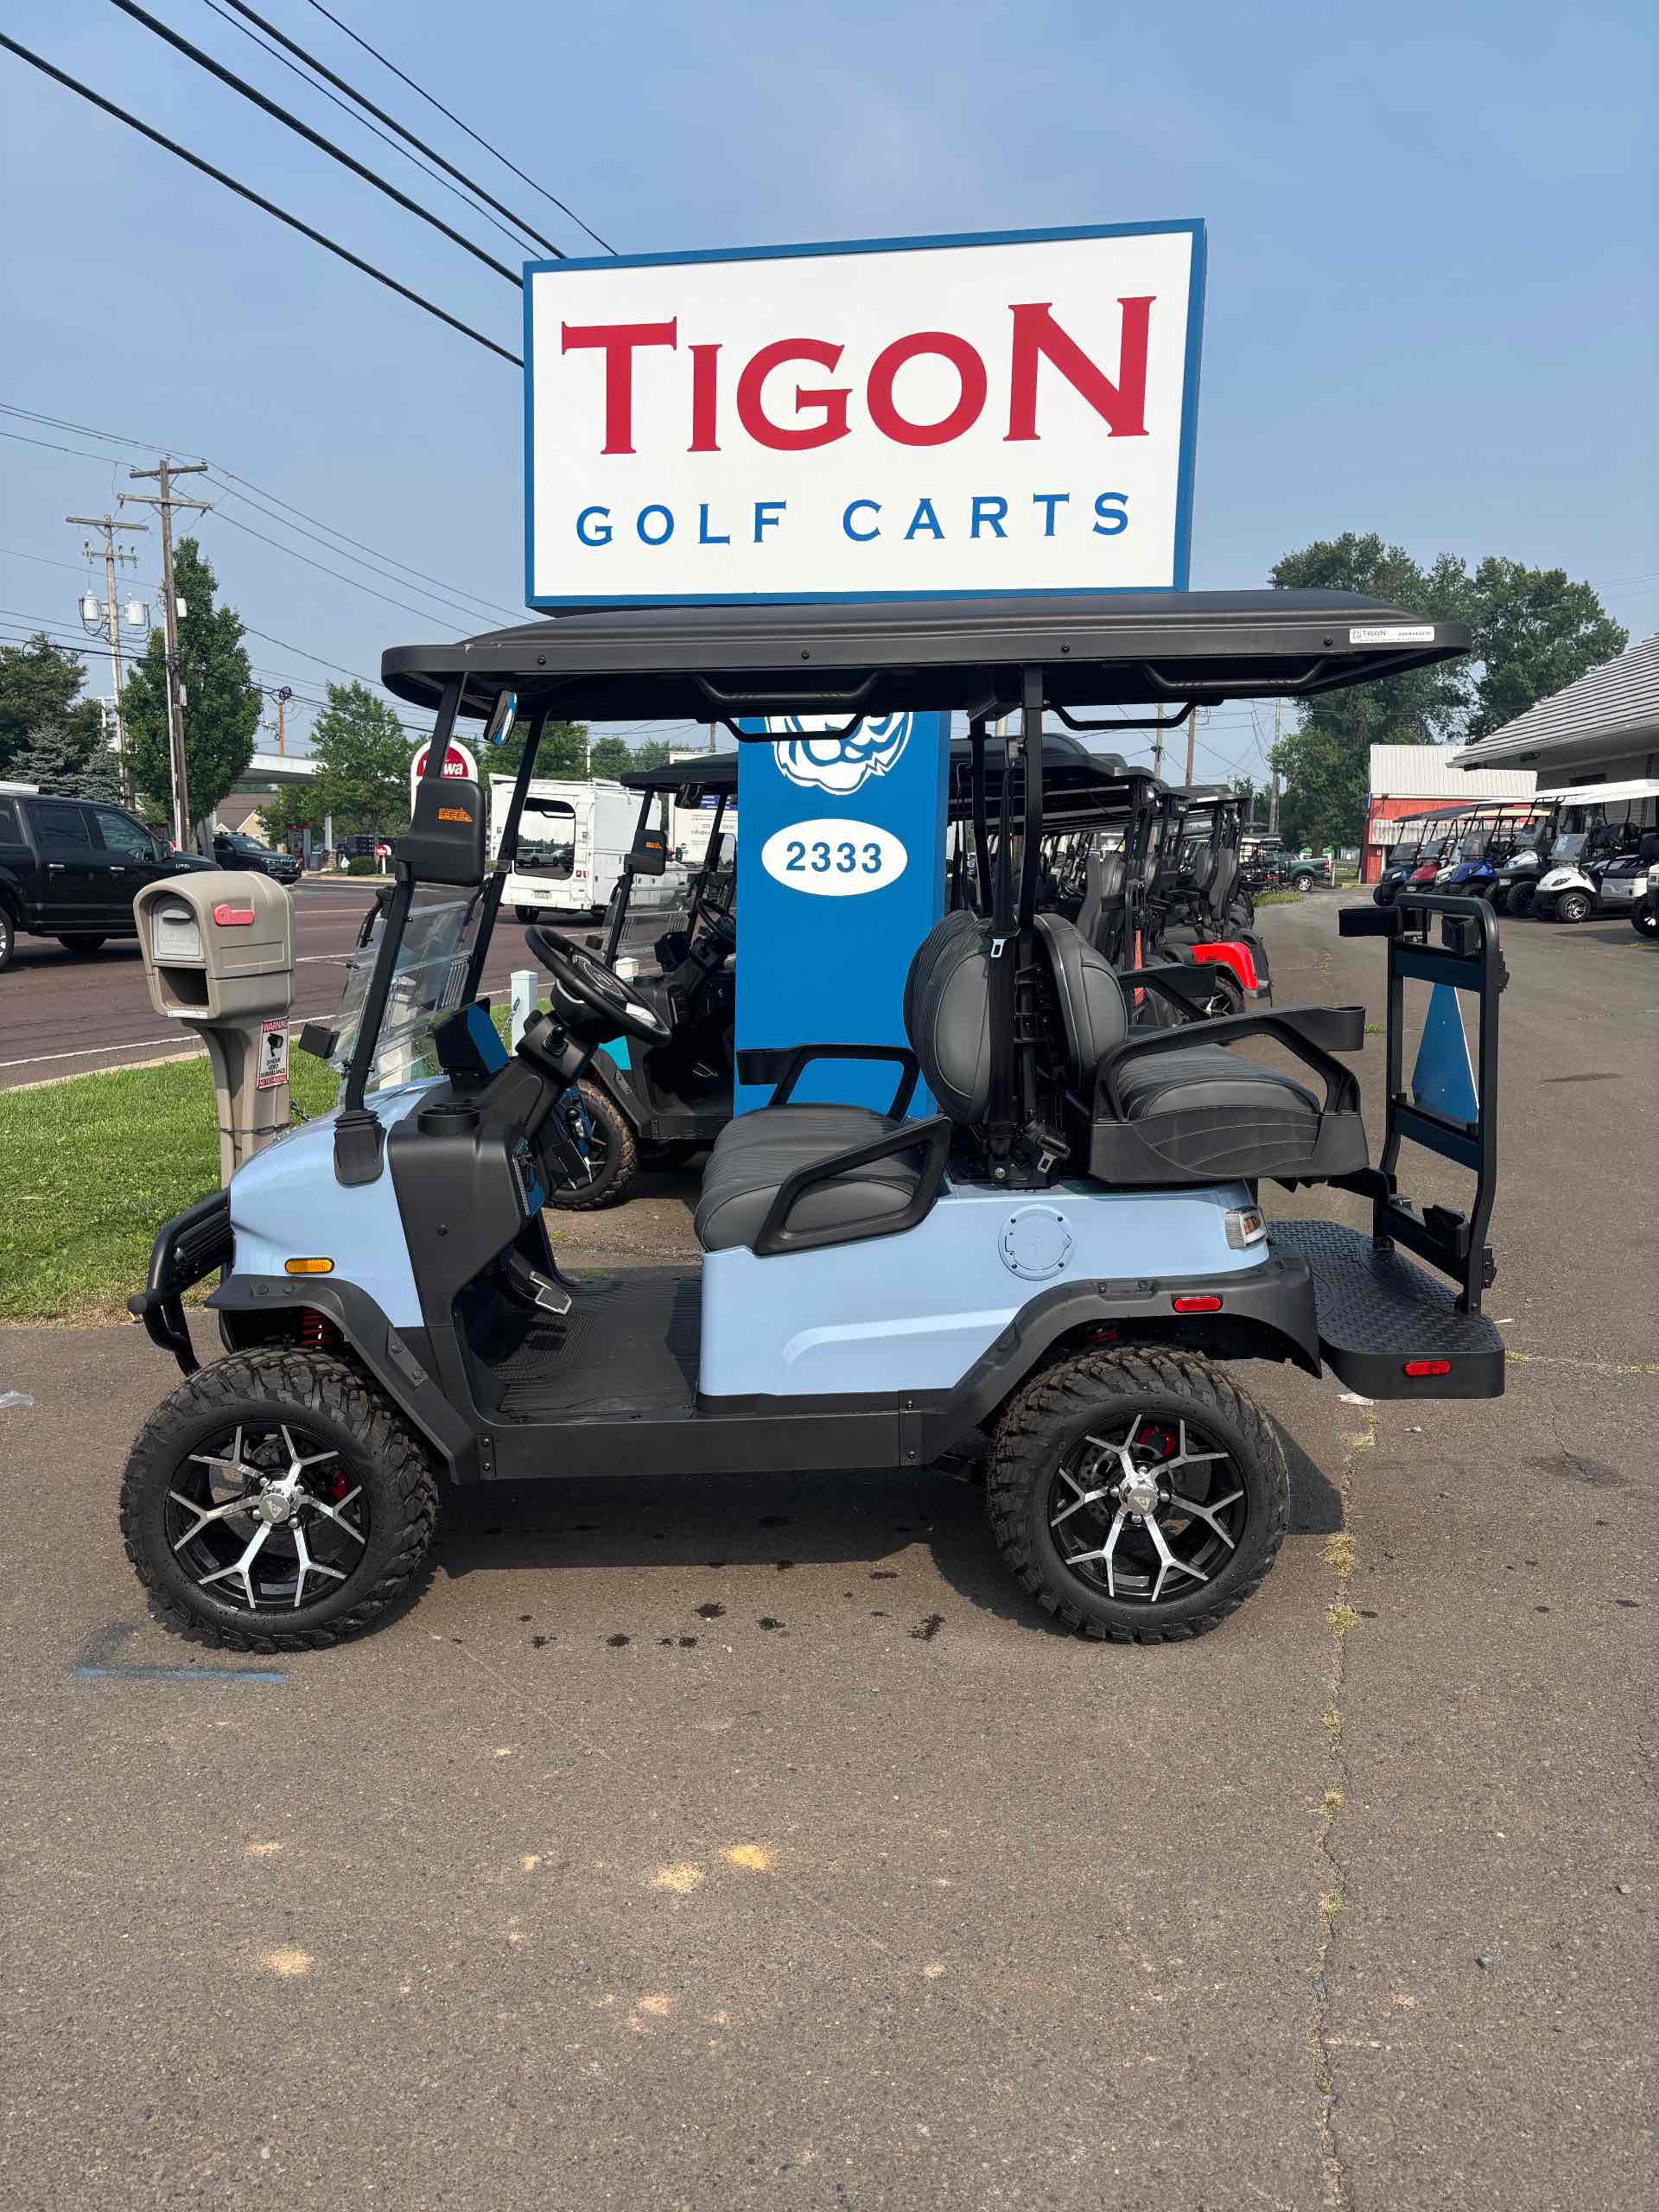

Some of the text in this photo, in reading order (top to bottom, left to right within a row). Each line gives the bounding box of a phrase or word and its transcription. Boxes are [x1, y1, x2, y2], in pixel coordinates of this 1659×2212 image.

[562, 296, 1156, 454] TIGON
[576, 492, 1129, 547] GOLF CARTS
[785, 841, 883, 874] 2333
